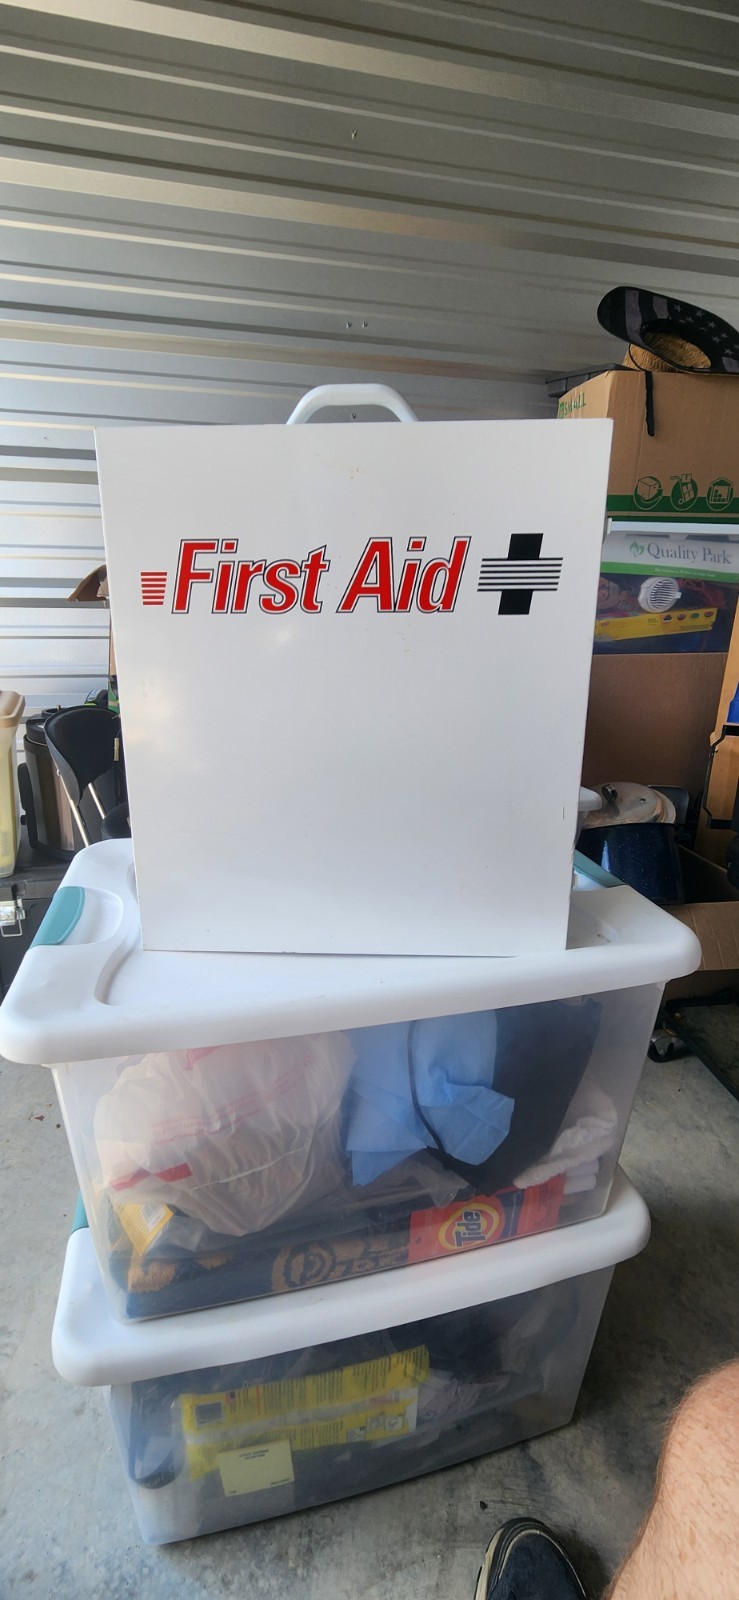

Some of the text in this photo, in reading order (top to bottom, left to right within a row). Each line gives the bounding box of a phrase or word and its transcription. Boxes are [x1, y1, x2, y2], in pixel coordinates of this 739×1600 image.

[647, 542, 732, 565] Quality Park
[171, 535, 472, 614] First Aid
[456, 1210, 488, 1248] Tide
